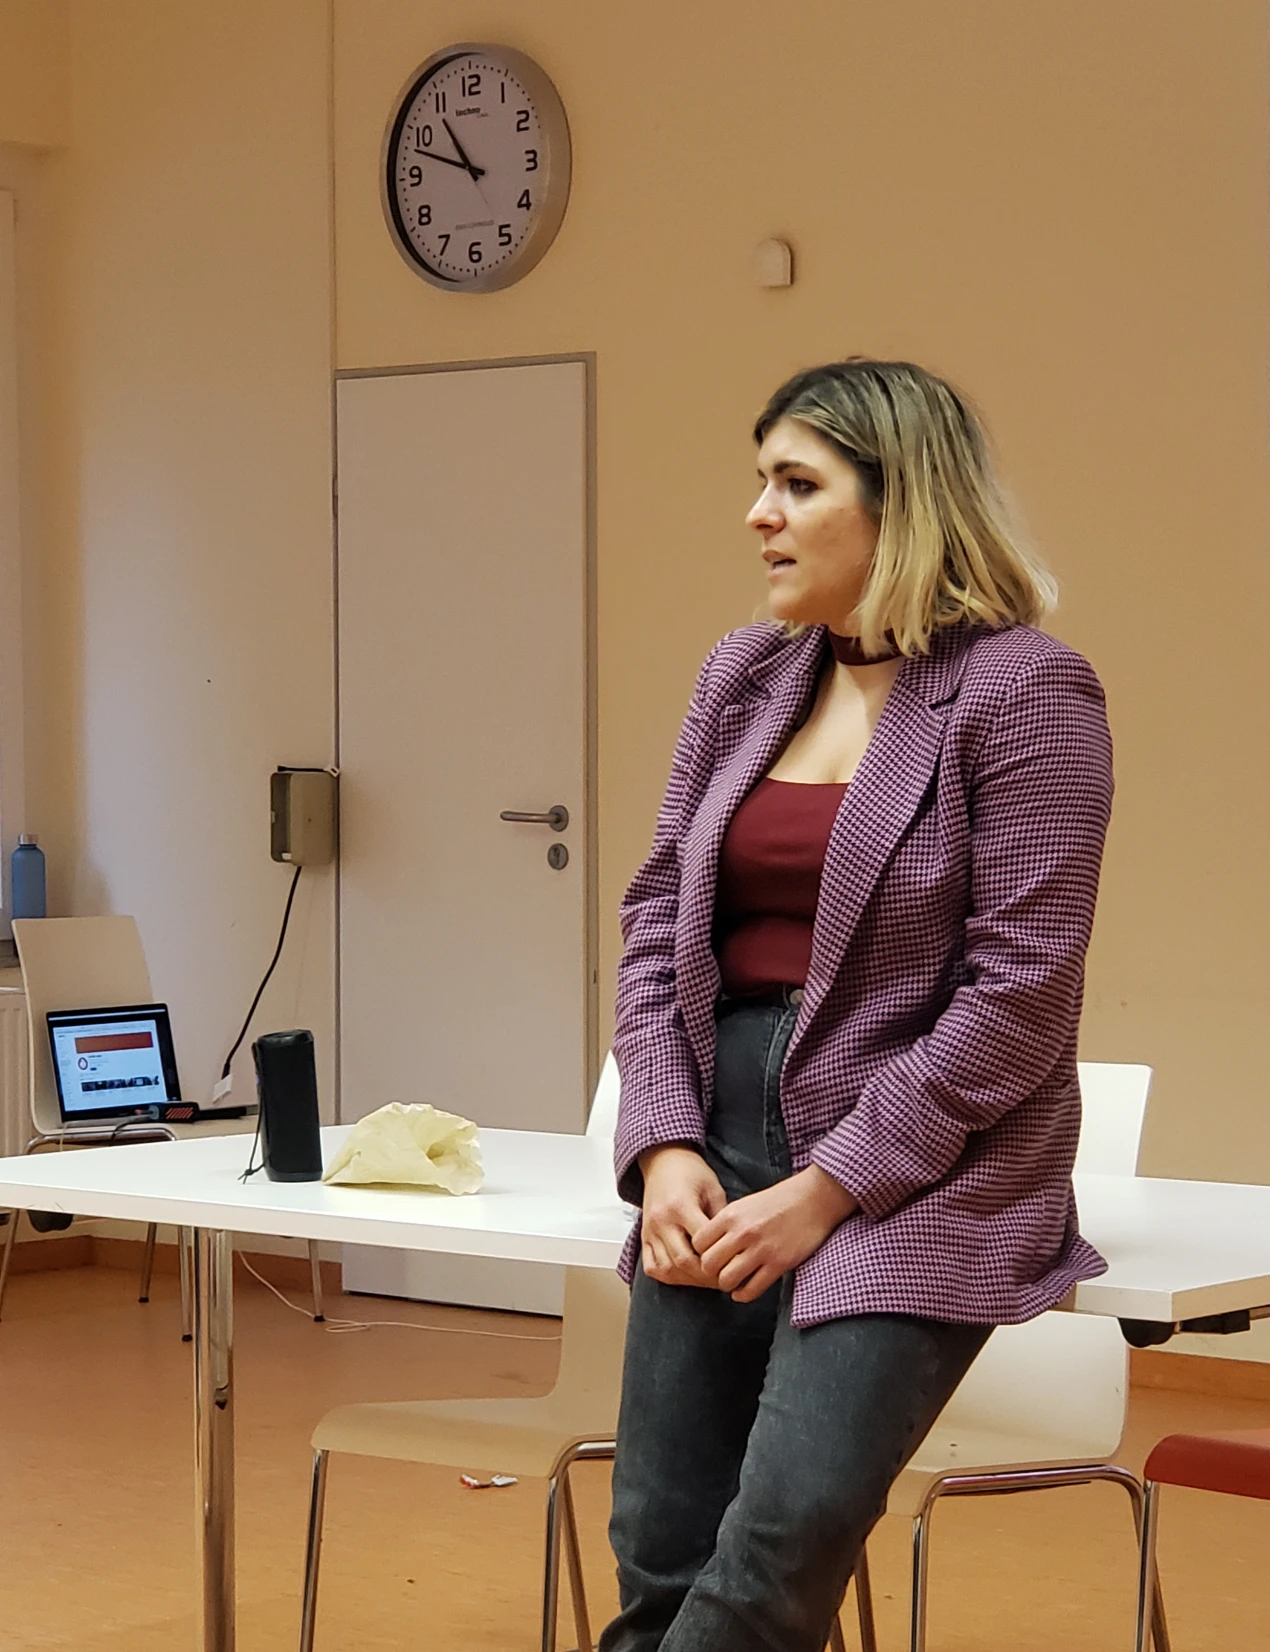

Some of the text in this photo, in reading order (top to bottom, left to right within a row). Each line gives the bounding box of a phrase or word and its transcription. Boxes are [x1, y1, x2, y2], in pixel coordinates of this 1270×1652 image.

[462, 74, 481, 97] 12
[500, 82, 506, 103] 1
[436, 92, 447, 113] 11
[516, 110, 529, 132] 2
[416, 125, 432, 148] 10
[525, 149, 538, 171] 3
[409, 166, 422, 187] 9
[517, 189, 531, 210] 4
[418, 205, 431, 226] 8
[438, 234, 450, 256] 7
[499, 224, 512, 246] 5
[469, 242, 482, 263] 6
